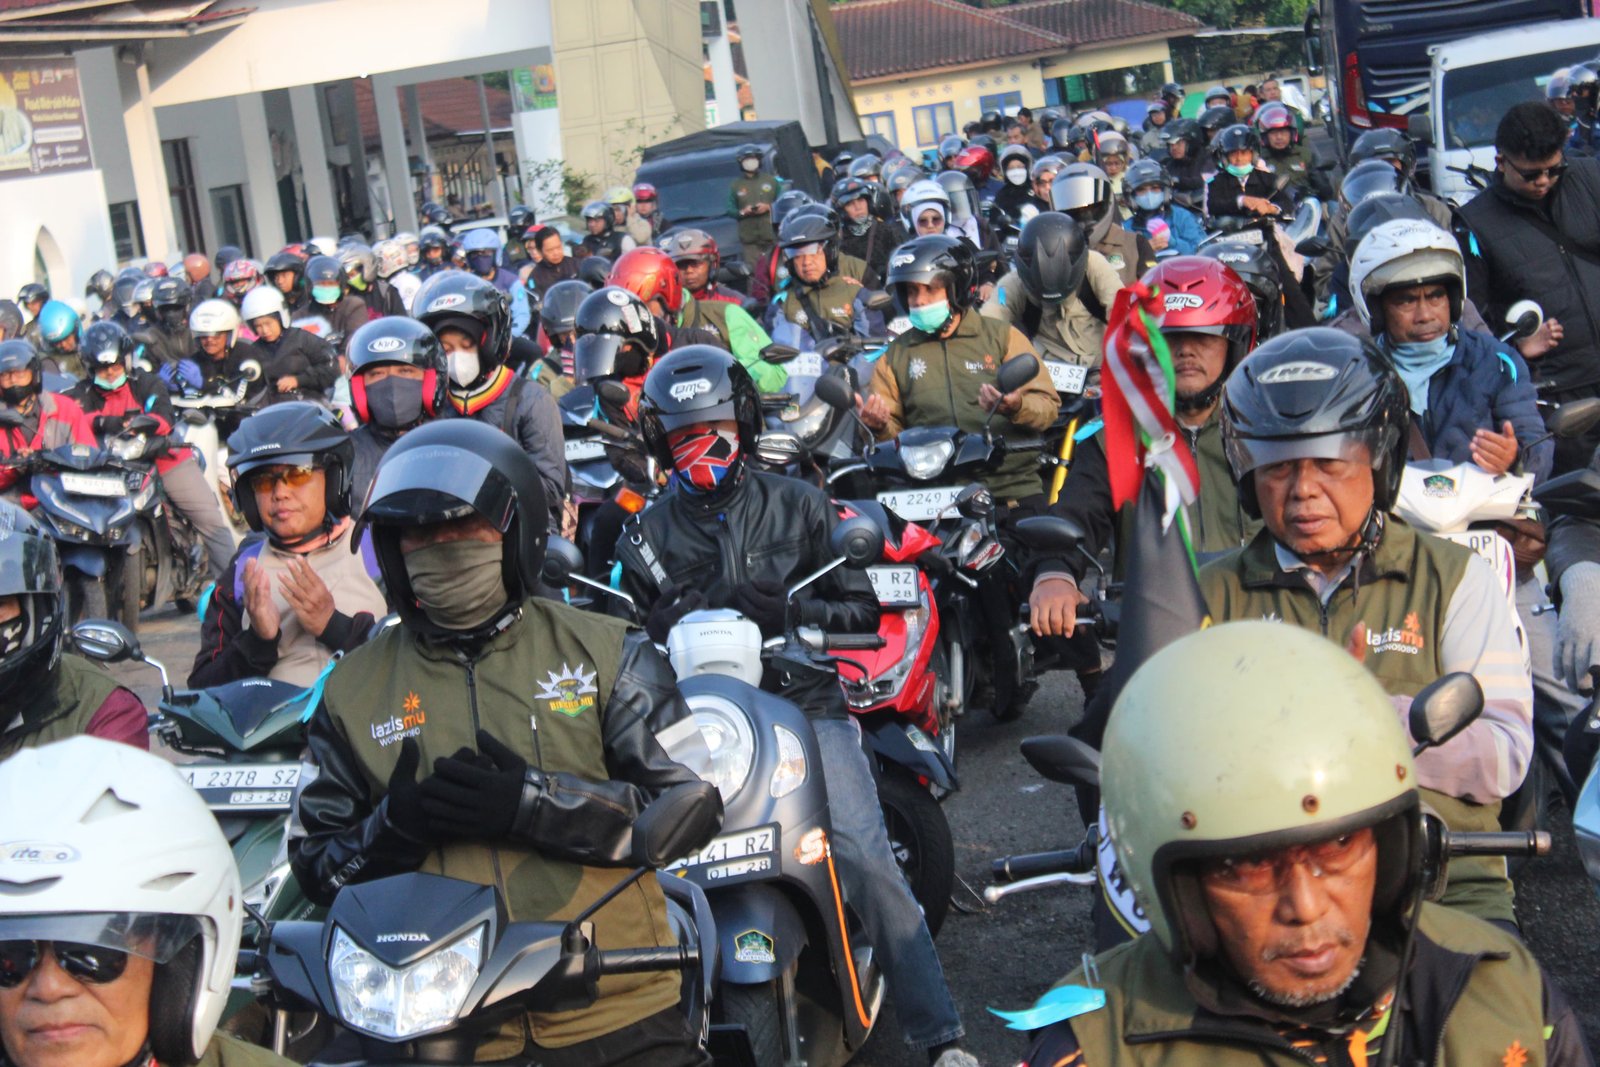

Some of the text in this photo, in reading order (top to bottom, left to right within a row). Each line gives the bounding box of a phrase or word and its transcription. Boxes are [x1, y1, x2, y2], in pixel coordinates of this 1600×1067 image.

[250, 443, 281, 454] HONDA
[906, 492, 942, 505] 2249
[891, 572, 912, 584] RZ
[1366, 627, 1424, 649] lazismu
[1373, 643, 1418, 655] WONOSOBO
[371, 710, 426, 739] lazismu
[207, 770, 257, 787] 2378
[272, 769, 298, 785] SZ
[745, 833, 769, 855] RZ
[376, 933, 431, 943] HONDA
